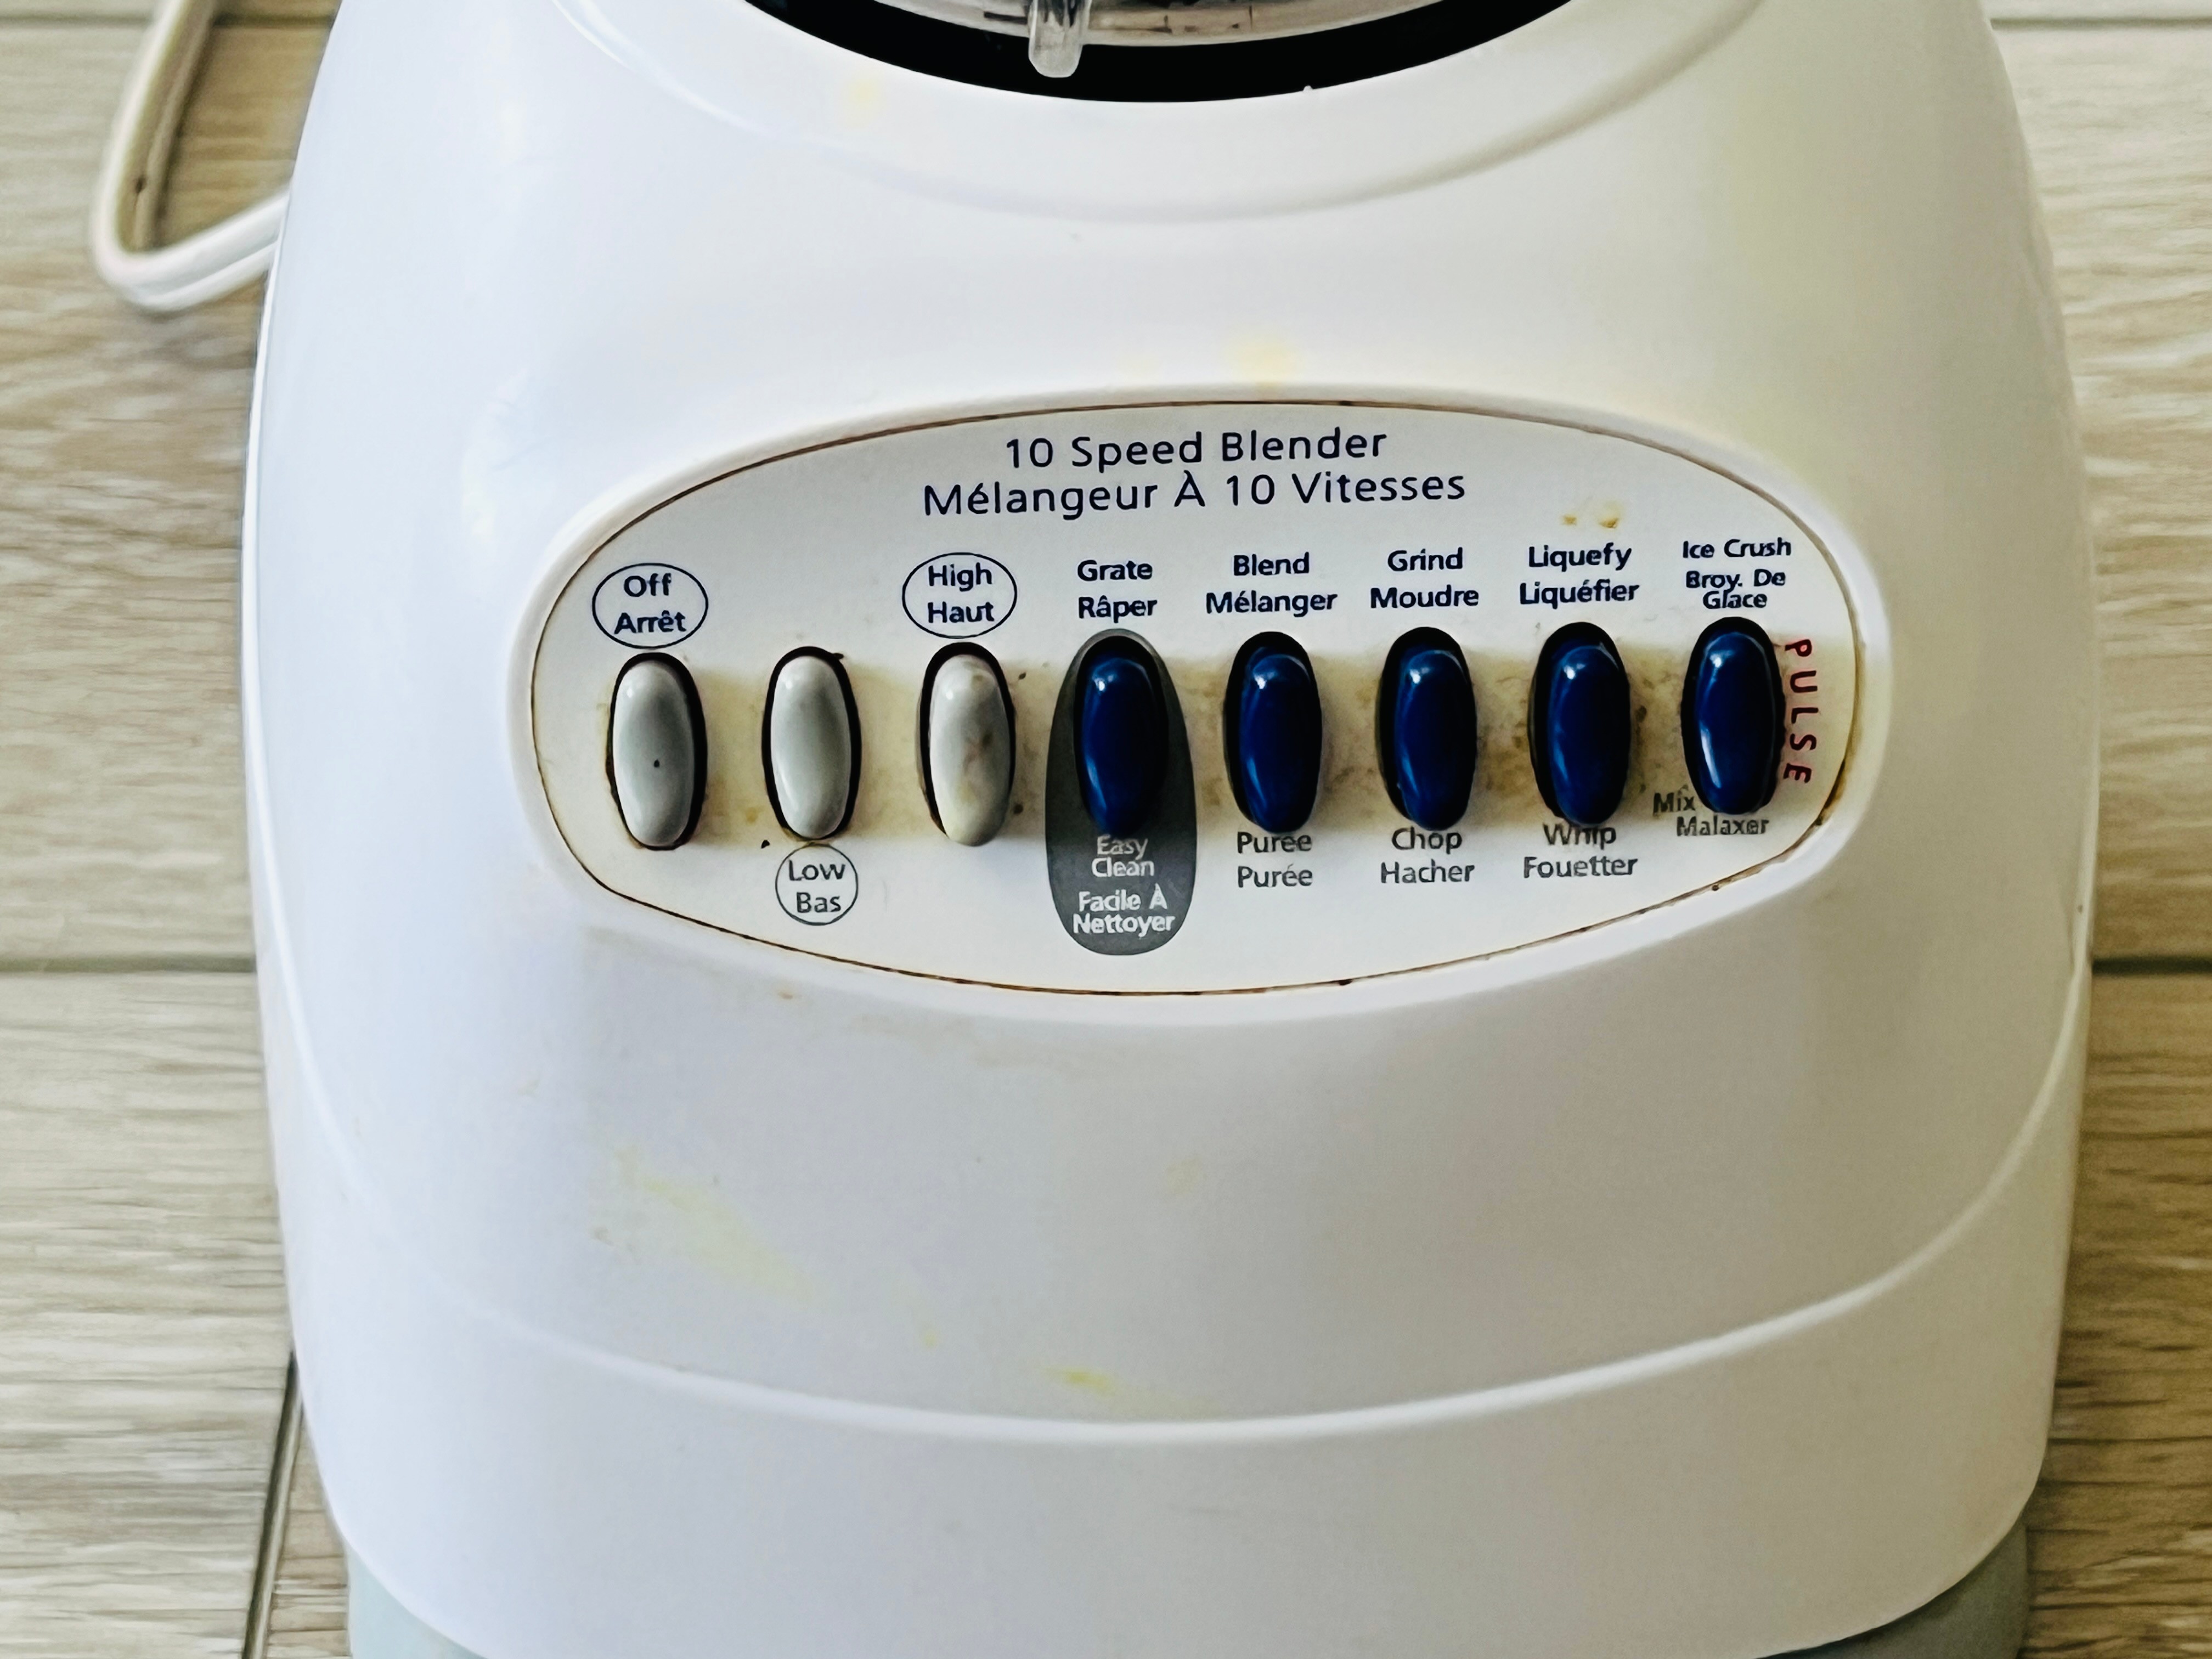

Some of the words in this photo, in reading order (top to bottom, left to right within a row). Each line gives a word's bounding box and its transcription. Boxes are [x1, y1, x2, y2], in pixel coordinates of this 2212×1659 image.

[1006, 439, 1054, 468] 10
[1072, 432, 1203, 473] Speed
[1222, 427, 1387, 461] Blender
[924, 480, 1158, 520] Mélangeur
[1175, 470, 1205, 506] À
[1227, 476, 1275, 505] 10
[1293, 471, 1465, 503] Vitesses
[1387, 548, 1463, 572] Grind
[1528, 543, 1633, 572] Liquefy
[1683, 540, 1714, 558] Ice
[1724, 538, 1792, 557] Crush
[1077, 560, 1153, 580] Grate
[1233, 552, 1309, 576] Blend
[623, 573, 672, 597] Off
[928, 563, 992, 591] High
[1686, 569, 1743, 593] Broy.
[1755, 569, 1786, 587] De
[1206, 591, 1337, 617] Mélanger
[1370, 585, 1479, 608] Moudre
[1520, 579, 1639, 609] Liquéfier
[1702, 591, 1768, 609] Glace
[927, 601, 995, 623] Haut
[1078, 595, 1157, 620] Râper
[614, 611, 686, 634] Arrêt
[1784, 639, 1818, 784] PULSE
[1653, 792, 1696, 815] Mix
[1677, 816, 1769, 837] Malaxer
[1097, 834, 1149, 860] Easy
[1391, 827, 1463, 854] Chop
[788, 860, 845, 882] Low
[1091, 857, 1155, 877] Clean
[1238, 864, 1313, 887] Purée
[1380, 860, 1475, 884] Hacher
[1523, 856, 1638, 879] Fouetter
[795, 893, 841, 913] Bas
[1079, 889, 1141, 912] Facile
[1073, 913, 1175, 938] Nettoyer
